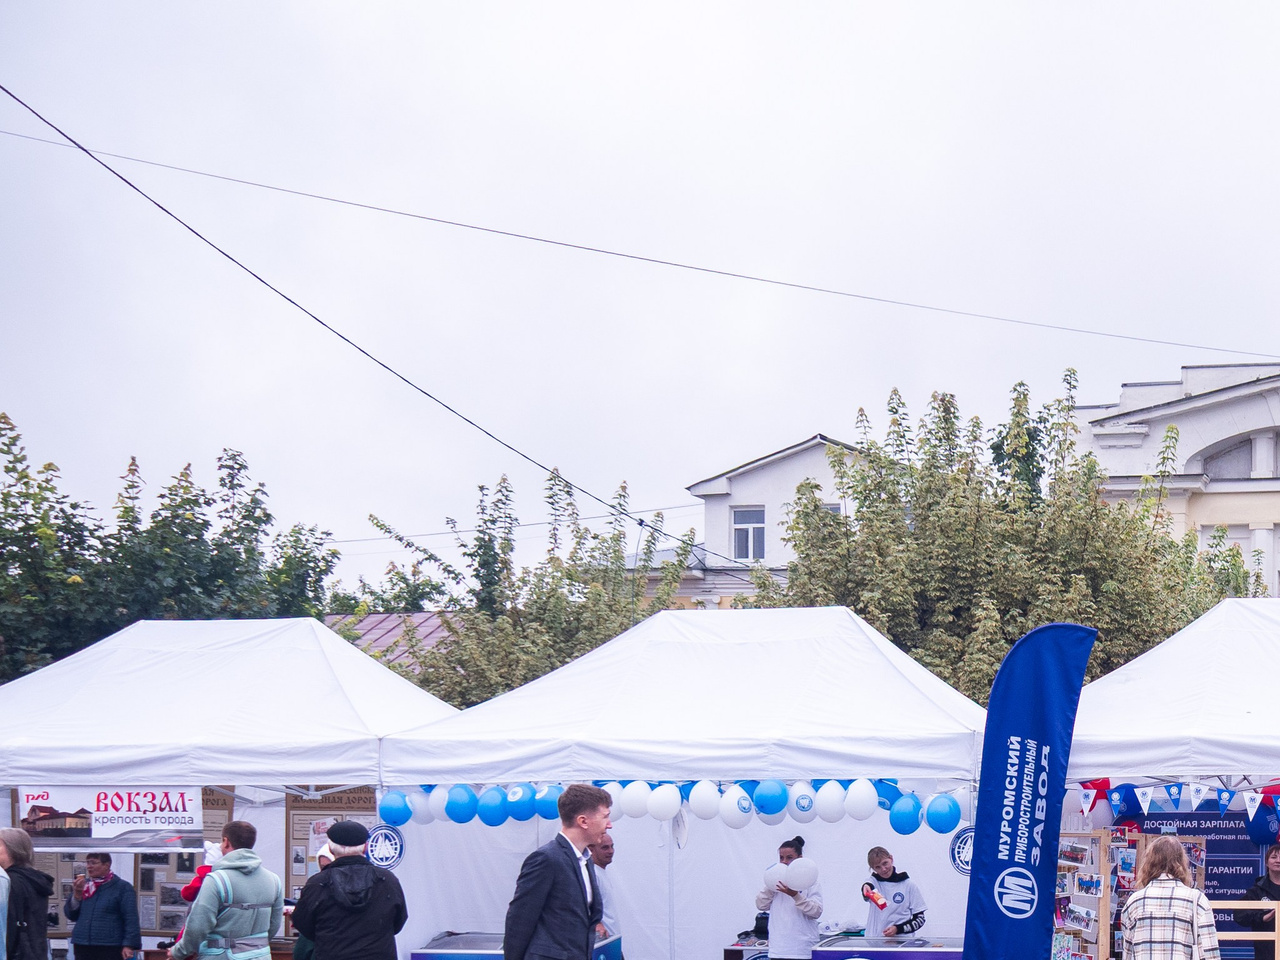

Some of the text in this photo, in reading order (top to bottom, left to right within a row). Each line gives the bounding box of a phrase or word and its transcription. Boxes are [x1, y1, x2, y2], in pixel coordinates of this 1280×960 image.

[95, 791, 193, 815] ВОКЗАЛ-
[998, 735, 1022, 860] МУРОМСКИЙ
[1014, 739, 1038, 863] ПРИБОРОСТРОИТЕЛЬНЫЙ
[1031, 745, 1050, 867] ЗАВОД
[94, 815, 194, 826] крепость города
[1144, 819, 1246, 829] ДОСТОЙНАЯ ЗАРПЛАТА
[1208, 866, 1253, 874] ГАРАНТИИ
